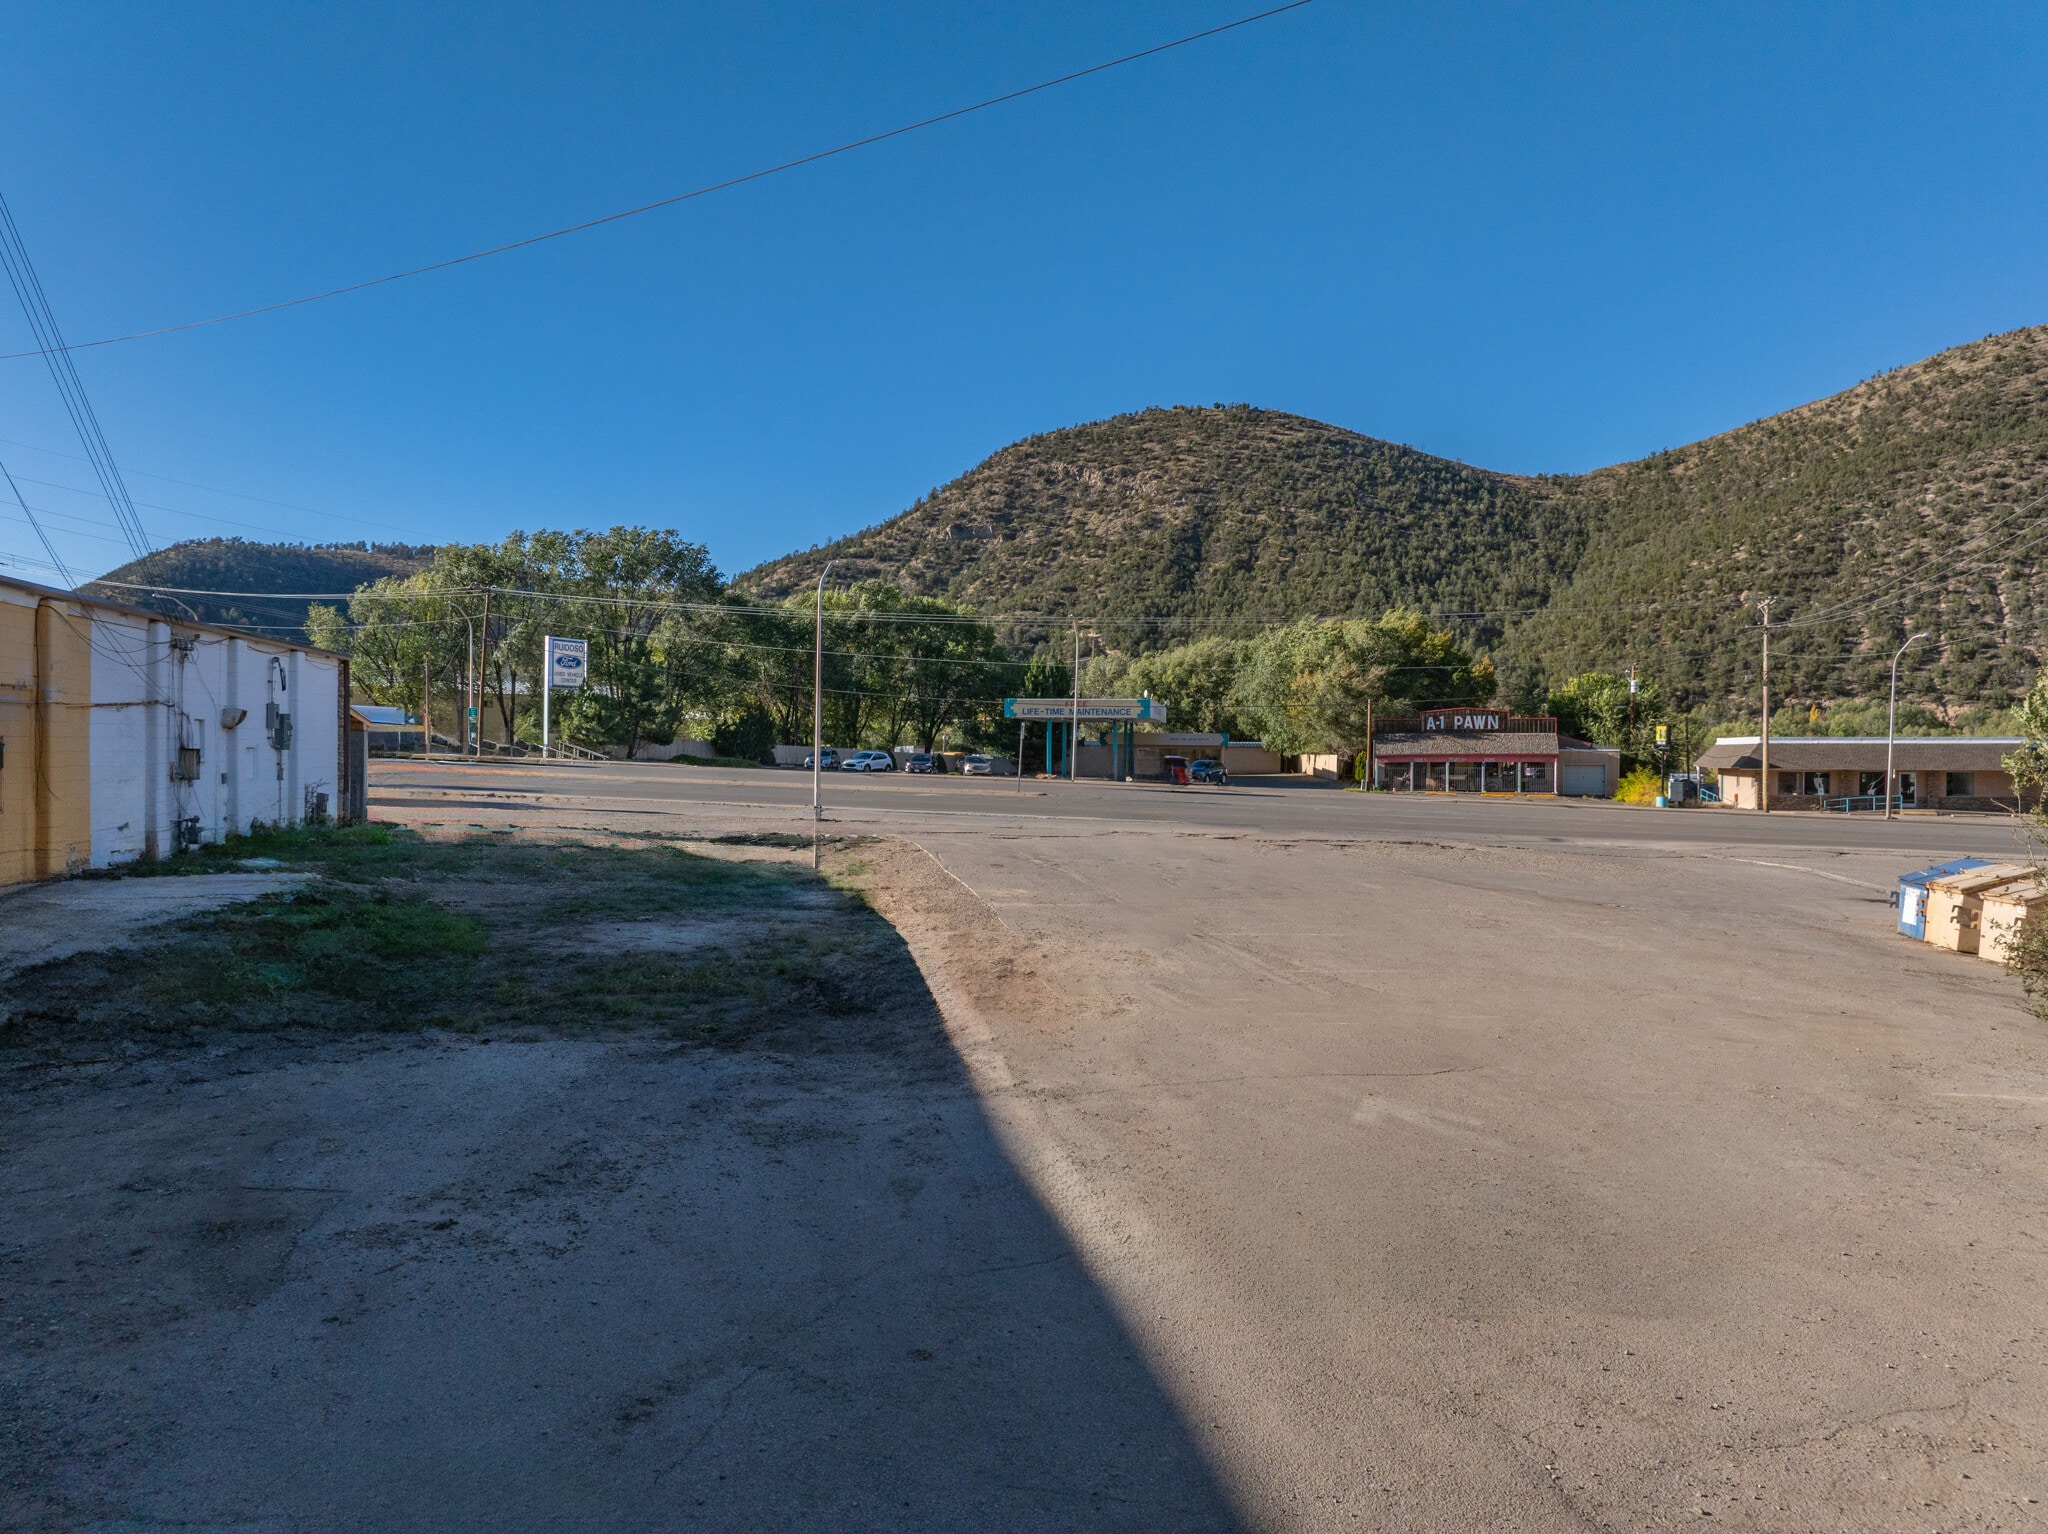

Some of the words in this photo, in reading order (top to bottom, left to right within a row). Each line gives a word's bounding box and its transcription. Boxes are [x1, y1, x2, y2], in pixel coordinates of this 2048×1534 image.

[554, 643, 584, 653] RUIDOSO
[560, 657, 577, 666] Ford
[1426, 716, 1445, 730] A-1
[1454, 715, 1499, 729] PAWN
